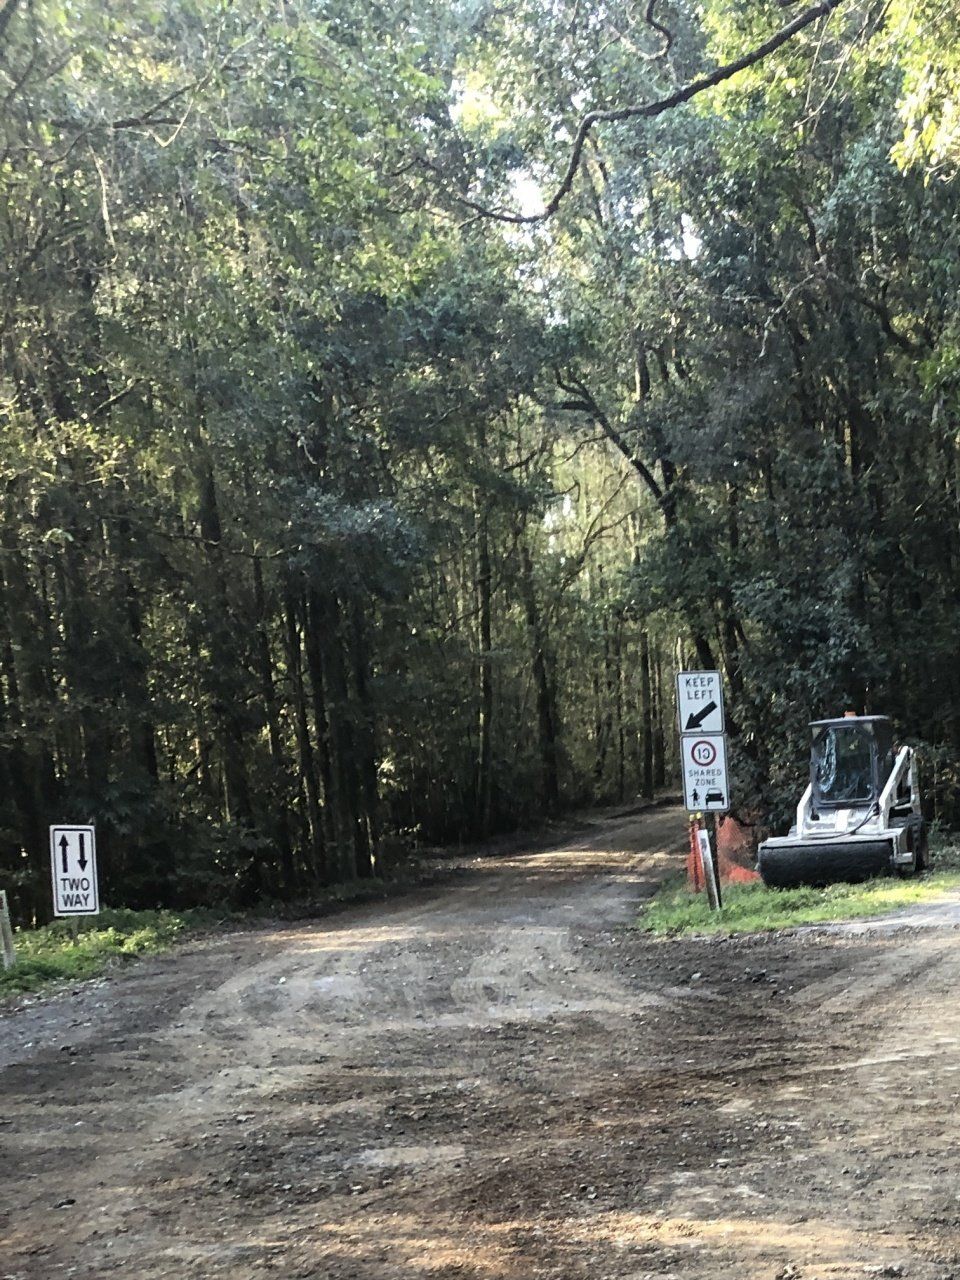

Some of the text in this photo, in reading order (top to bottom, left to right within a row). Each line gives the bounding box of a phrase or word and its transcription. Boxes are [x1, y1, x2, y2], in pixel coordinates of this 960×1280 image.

[685, 677, 714, 687] KEEP
[687, 690, 714, 700] LEFT
[697, 748, 711, 760] 10
[688, 769, 722, 778] SHARED
[695, 778, 717, 786] ZONE
[60, 878, 90, 891] TWO
[62, 893, 90, 907] WAY
